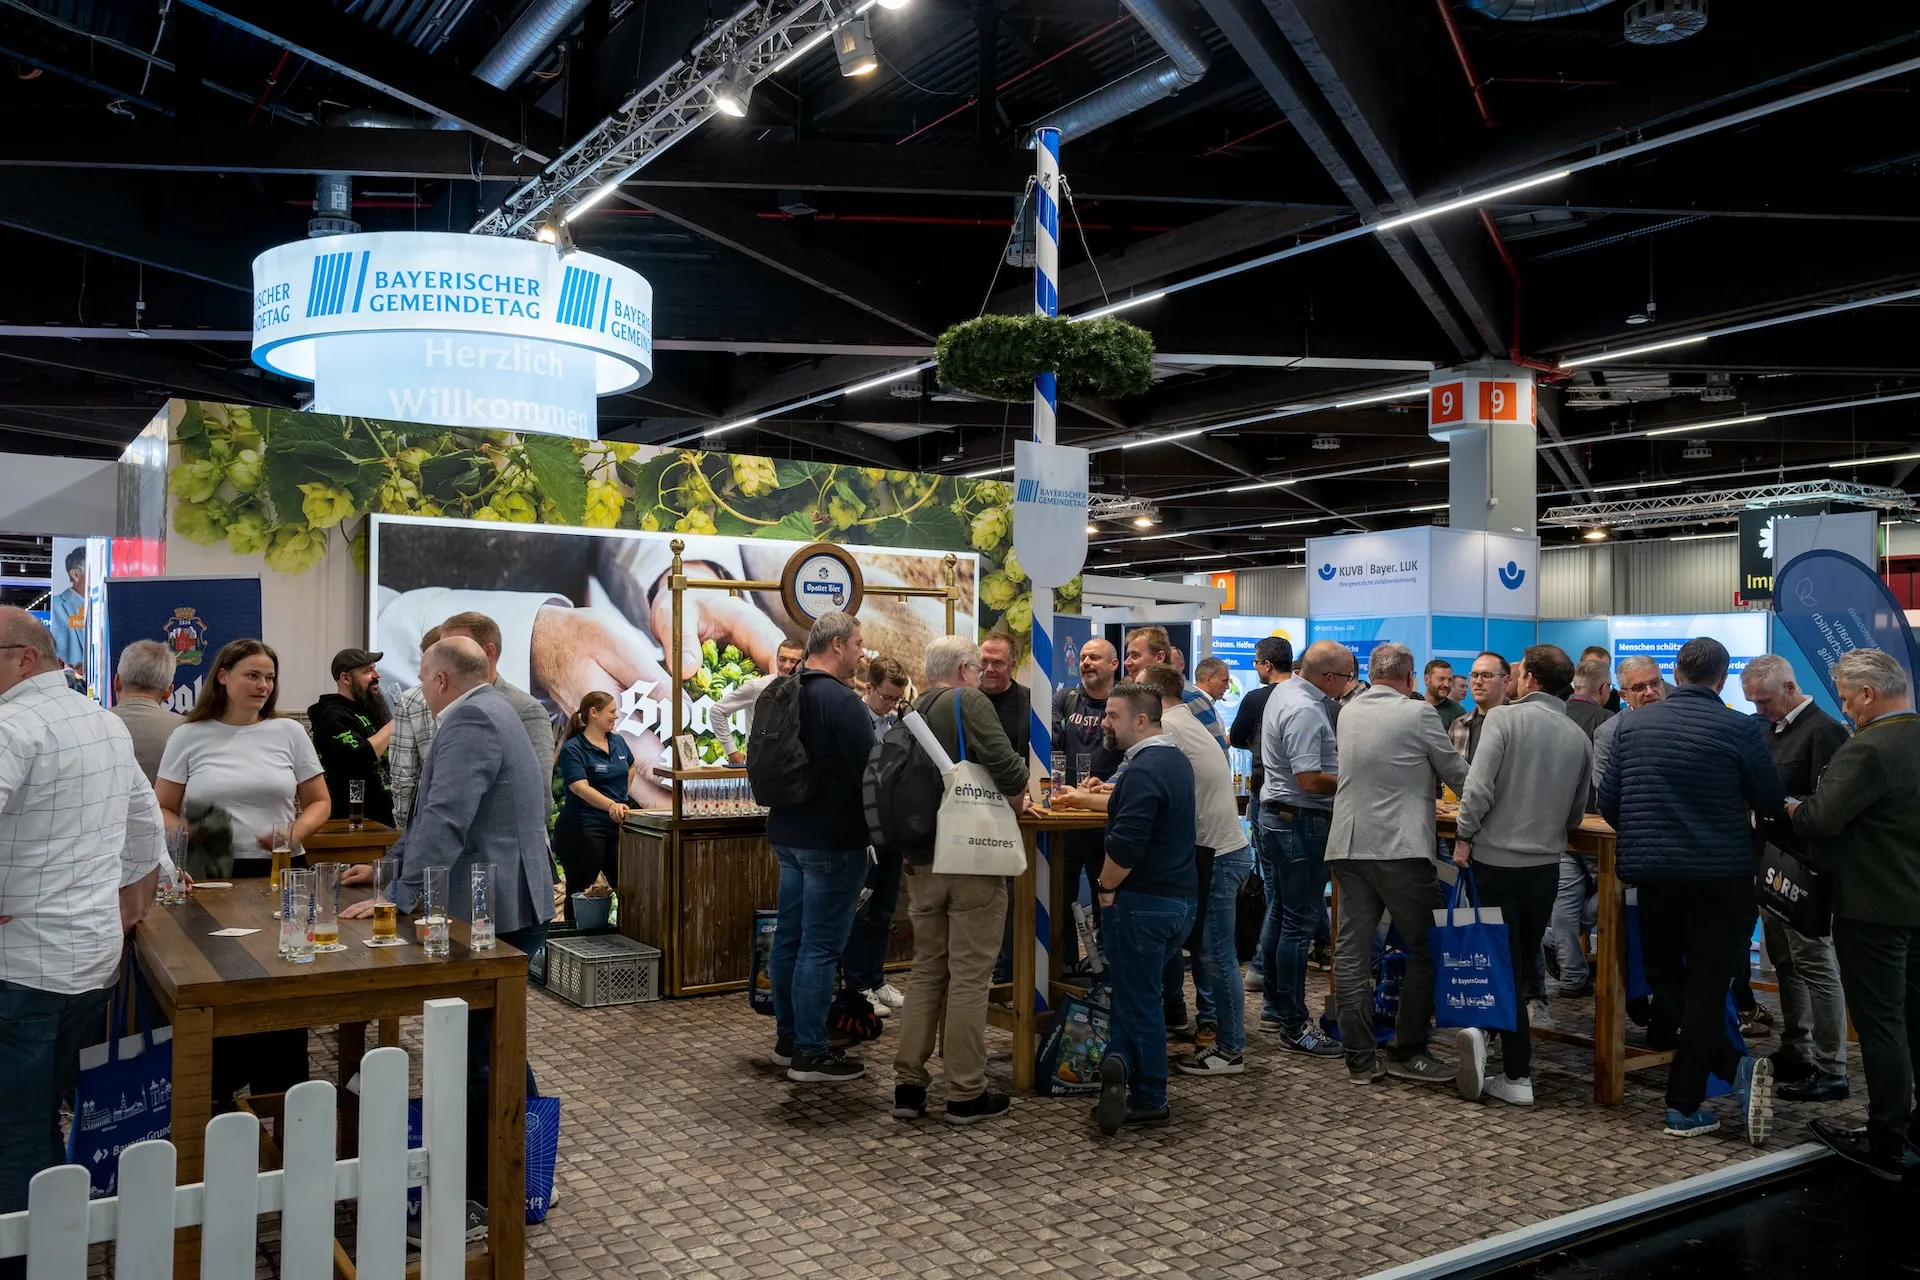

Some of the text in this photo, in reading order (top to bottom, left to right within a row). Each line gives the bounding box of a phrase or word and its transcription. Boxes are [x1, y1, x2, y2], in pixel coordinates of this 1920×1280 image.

[375, 271, 540, 297] BAYERISCHER
[369, 294, 540, 319] GEMEINDETAG
[425, 337, 563, 379] Herzlich
[1441, 391, 1454, 415] 9
[1491, 389, 1504, 413] 9
[387, 387, 589, 433] Willkommen
[1040, 489, 1087, 499] BAYERISCHER
[1038, 497, 1087, 508] GEMEINDETAG
[1339, 560, 1418, 576] KUVB Bayer. LUK
[1236, 641, 1255, 649] Helfen
[1618, 643, 1656, 651] Menschen
[1658, 661, 1674, 669] und
[968, 837, 1014, 848] auctores
